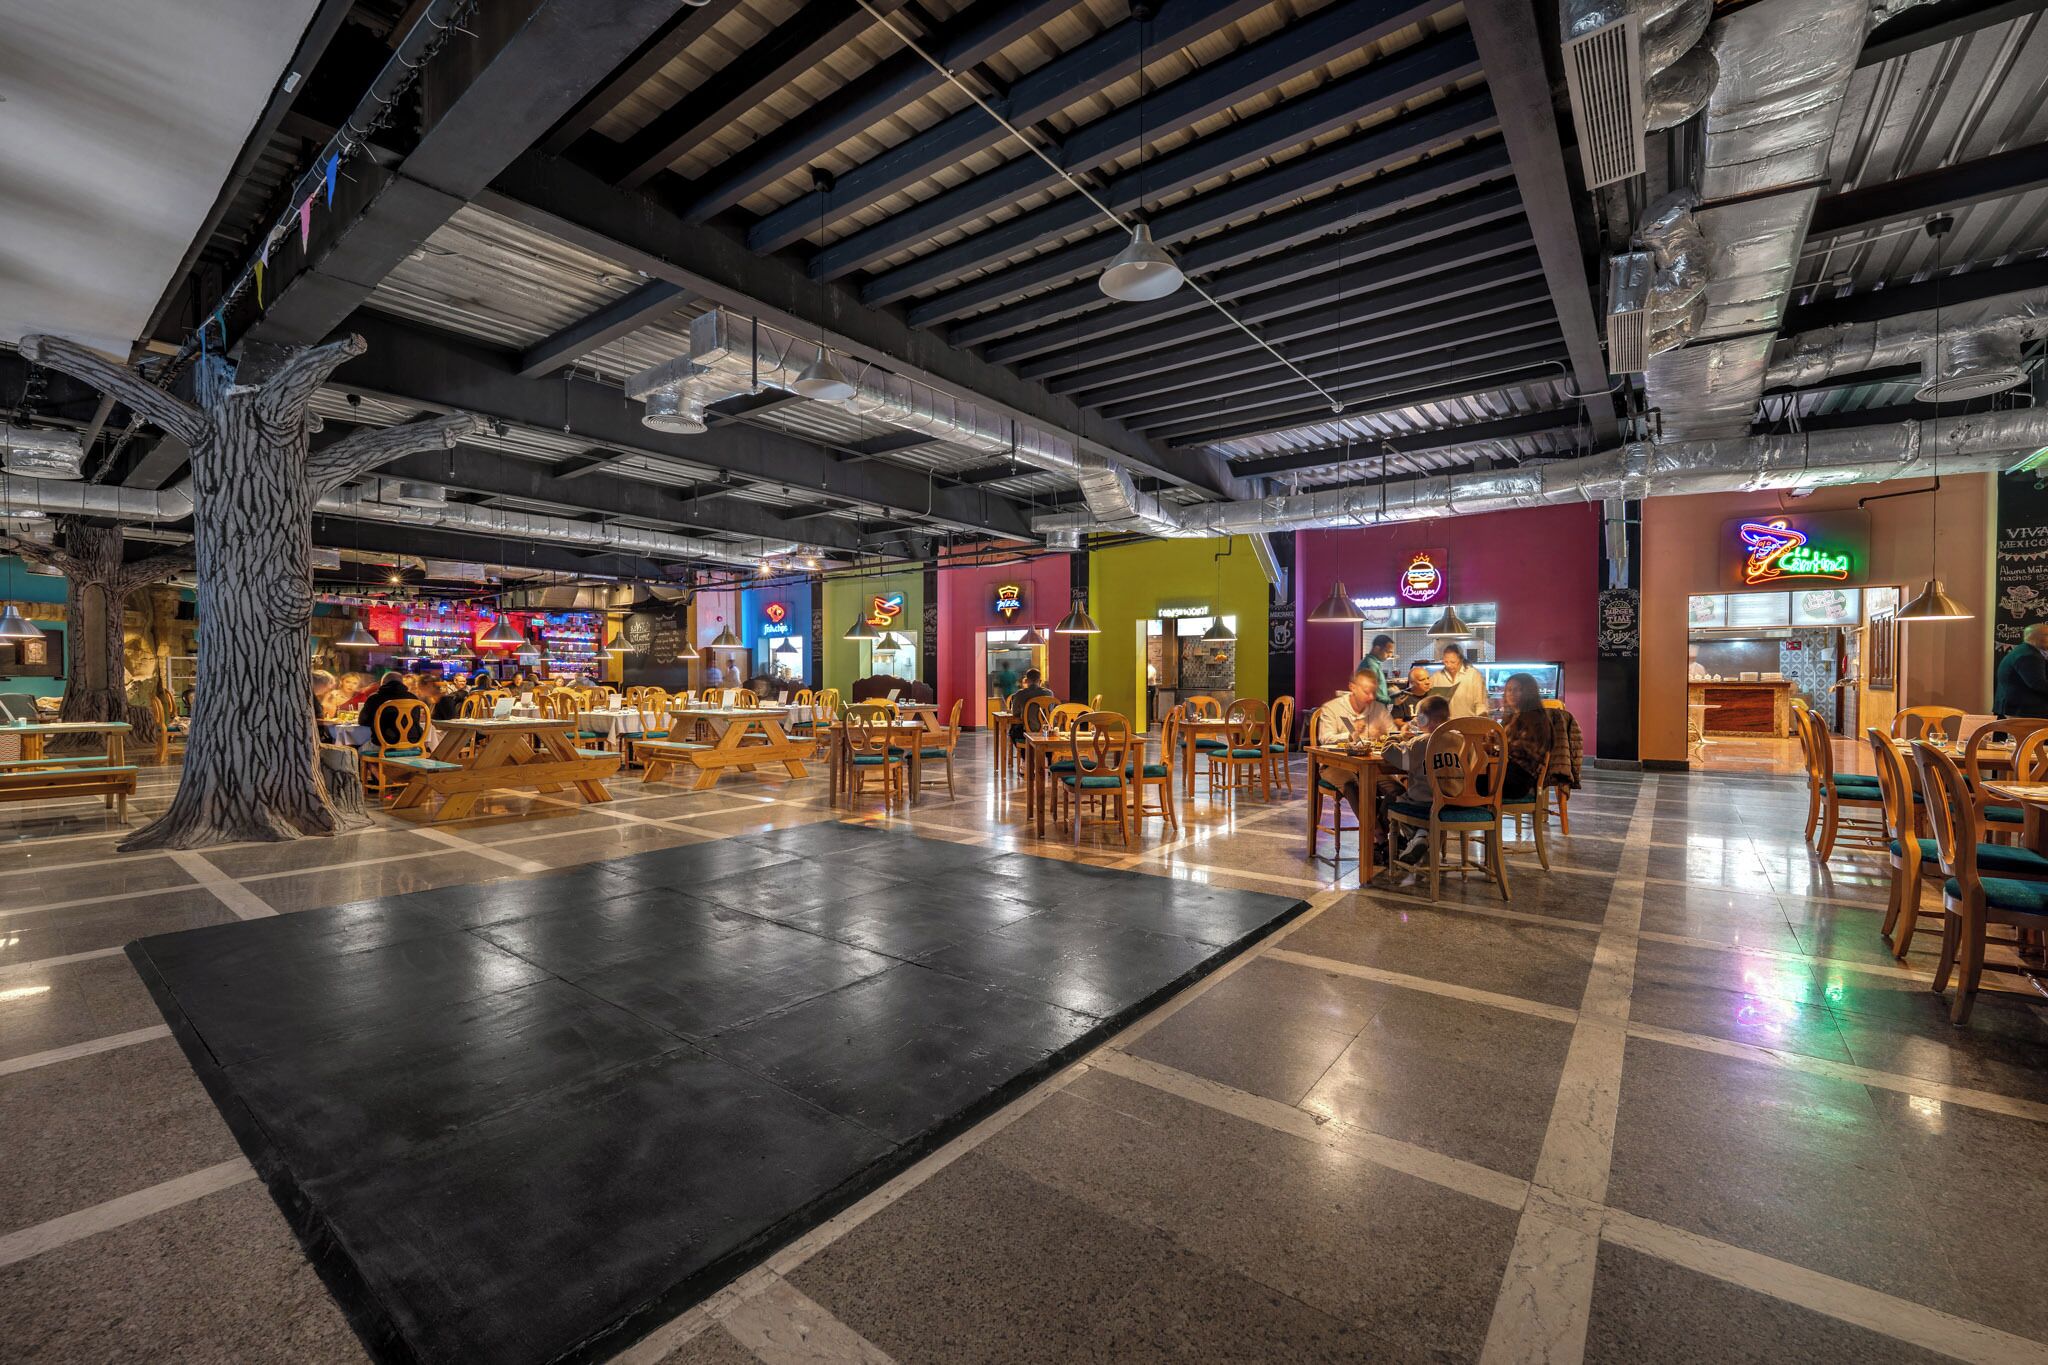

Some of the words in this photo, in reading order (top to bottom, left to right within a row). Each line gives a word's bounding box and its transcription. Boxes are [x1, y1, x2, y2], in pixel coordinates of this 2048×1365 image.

[2007, 526, 2048, 538] VIVA
[1779, 551, 1848, 573] Cantina
[1402, 586, 1435, 601] Burger
[1606, 629, 1631, 644] Enjoy
